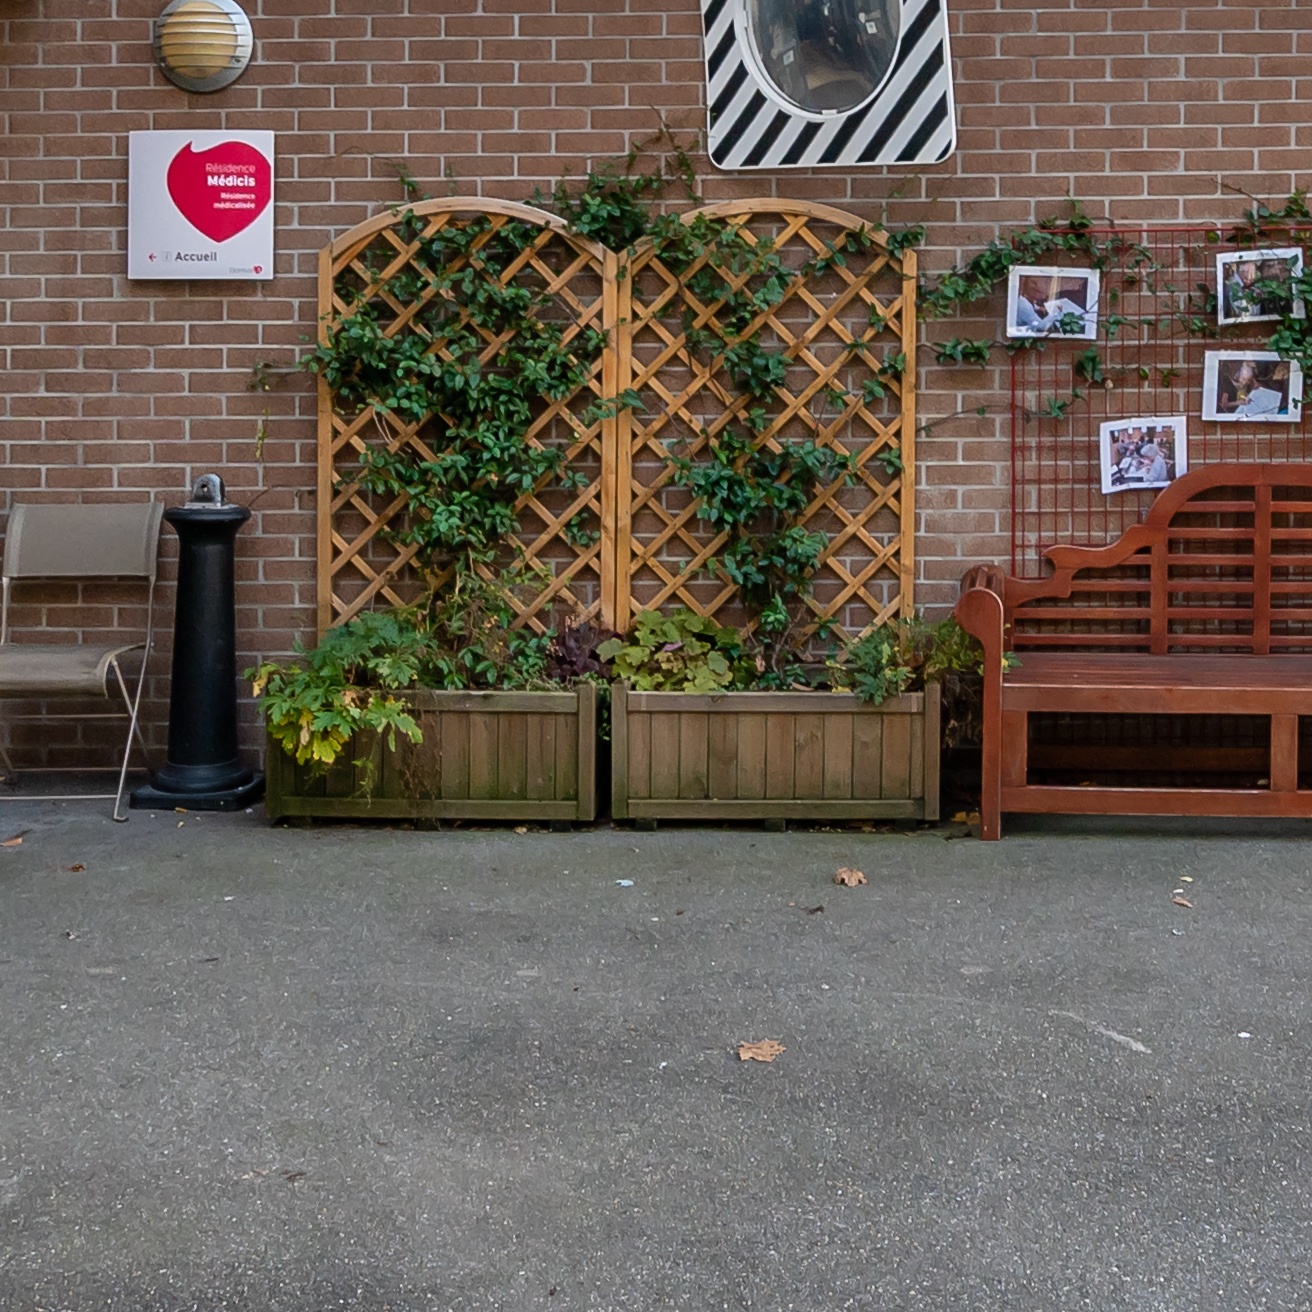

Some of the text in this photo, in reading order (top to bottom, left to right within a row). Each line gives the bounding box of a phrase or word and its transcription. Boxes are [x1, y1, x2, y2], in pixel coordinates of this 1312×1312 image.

[205, 162, 256, 174] Résidence
[207, 174, 256, 187] Médicis
[174, 251, 218, 262] Accueil
